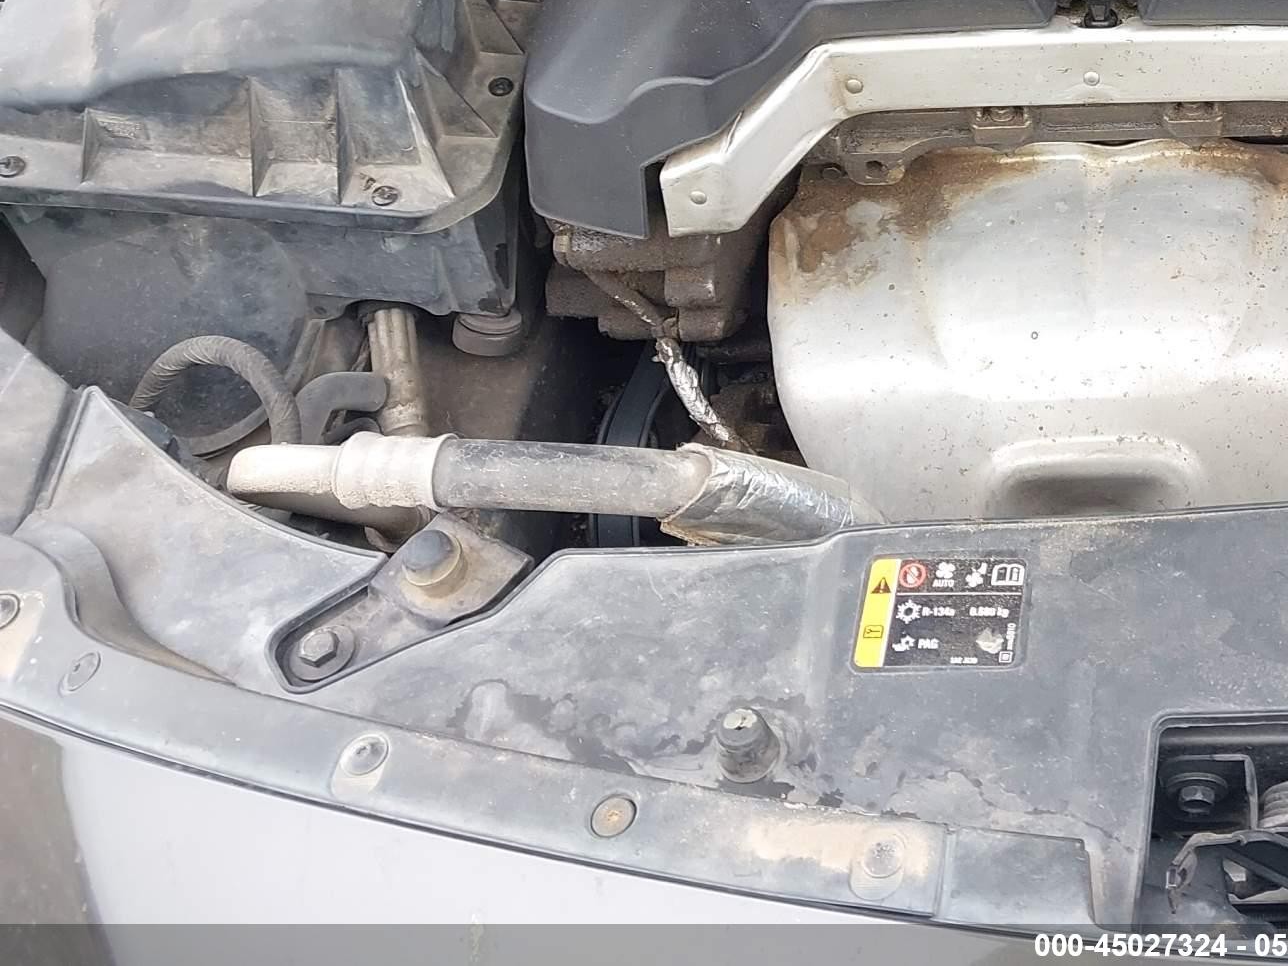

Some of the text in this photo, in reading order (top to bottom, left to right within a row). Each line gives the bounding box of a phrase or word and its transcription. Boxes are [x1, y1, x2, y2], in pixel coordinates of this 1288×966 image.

[932, 579, 955, 588] AUTO
[922, 607, 955, 616] R-134a
[917, 638, 940, 649] PAG
